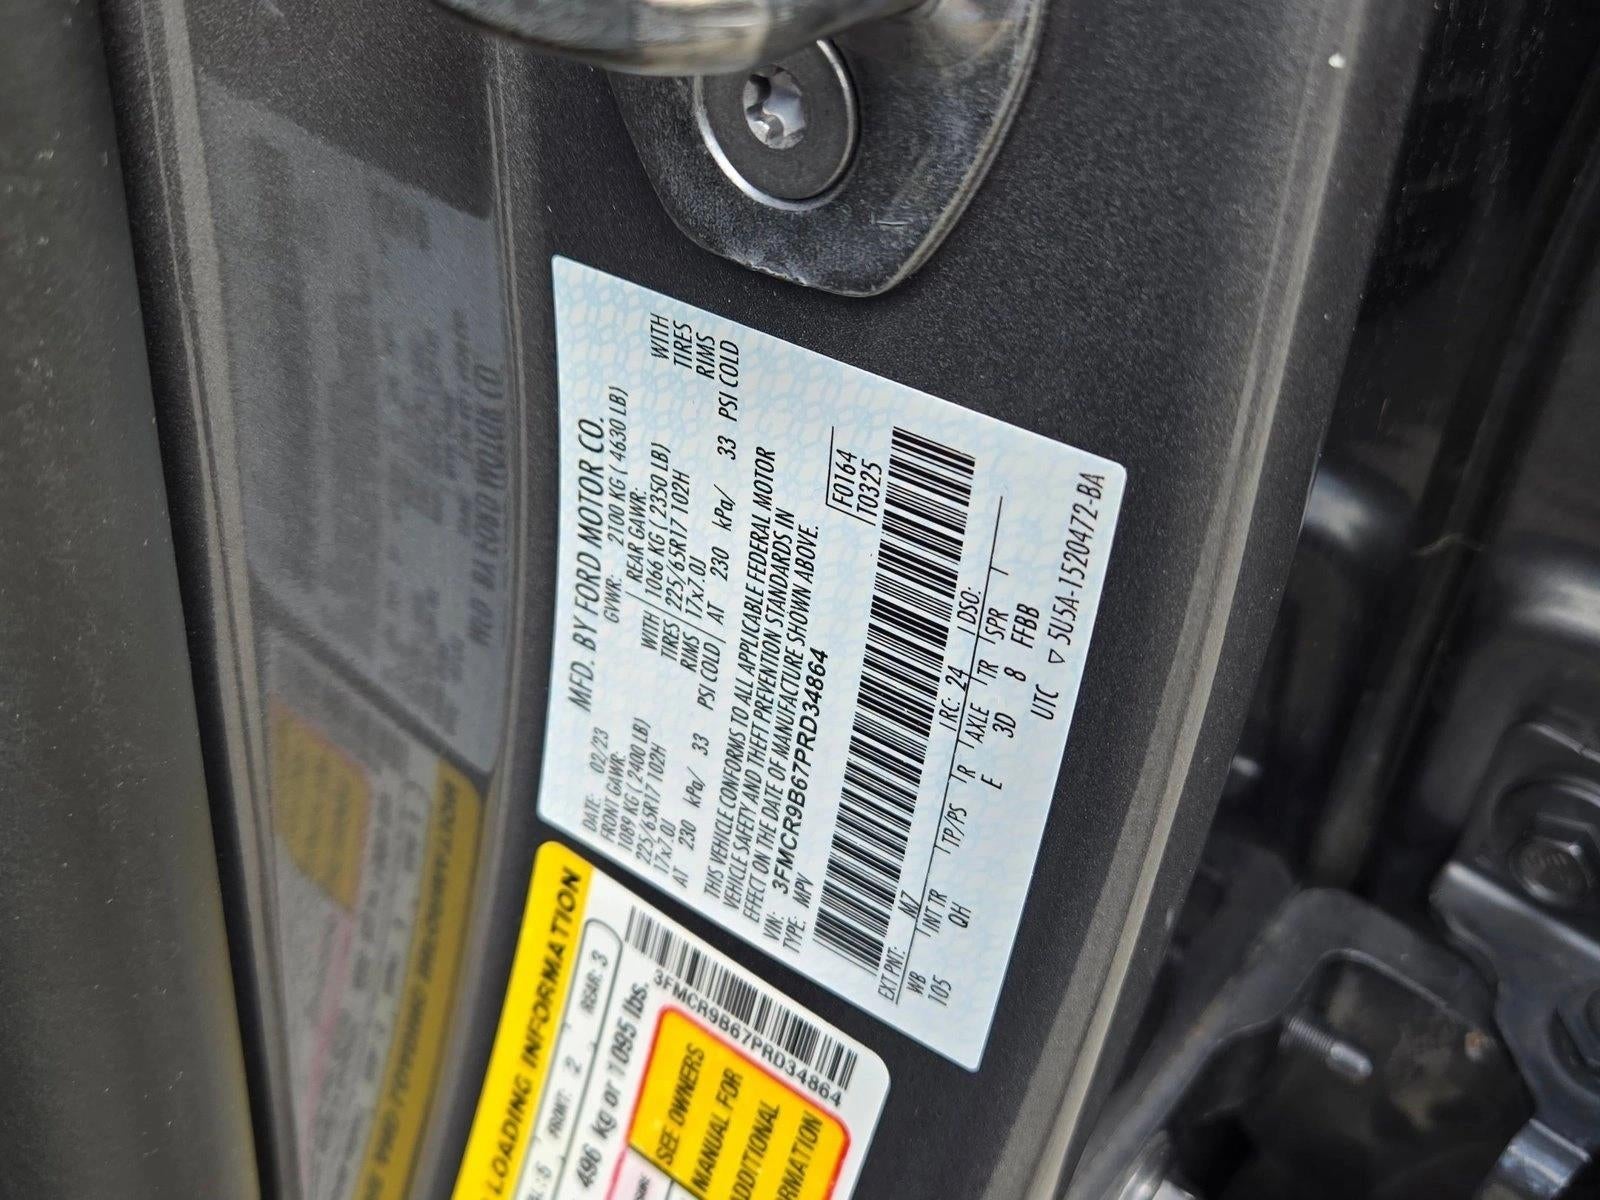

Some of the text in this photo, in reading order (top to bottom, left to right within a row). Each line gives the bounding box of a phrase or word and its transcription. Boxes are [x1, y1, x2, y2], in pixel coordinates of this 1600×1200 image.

[650, 312, 669, 360] WITH
[674, 320, 692, 369] TIRES
[696, 332, 715, 380] RIMS
[609, 386, 628, 416] LB)
[718, 340, 739, 422] PSI COLD
[609, 418, 626, 462] 4630
[651, 442, 671, 472] LB)
[608, 476, 626, 504] KG
[650, 474, 668, 519] 2350
[856, 458, 882, 516] T0325
[608, 505, 626, 546] 2100
[626, 488, 647, 584] REAR GAWR:
[648, 532, 665, 558] KG
[666, 469, 690, 611] 225/65R17 102H
[706, 436, 736, 626] AT 230 kPa/ 33
[568, 417, 605, 713] MFD. BY FORD MOTOR CO.
[645, 559, 664, 599] 1066
[685, 555, 707, 619] 17x7.0J
[604, 574, 622, 624] GVWR:
[957, 586, 982, 625] DSO:
[1030, 473, 1105, 720] UTC 5U5A-1520472-BA
[641, 610, 660, 650] WITH
[661, 620, 680, 661] TIRES
[985, 608, 1009, 640] SPR
[1010, 603, 1040, 649] FFBB
[680, 632, 700, 672] RIMS
[704, 446, 775, 900] THIS VEHICLE CONFORMS TO ALL APPLICABLE FEDERAL MOTOR
[977, 658, 998, 679] TR
[1004, 666, 1026, 682] 8
[698, 642, 720, 711] PSI COLD
[939, 665, 968, 725] RC: 24
[632, 717, 651, 744] LB)
[722, 508, 794, 911] VEHICLE SAFETY AND THEFT PREVENTION STANDARDS IN
[743, 524, 818, 924] EFFECT ON THE DATE OF MANUFACTURE SHOWN ABOVE.
[965, 702, 990, 744] AXLE
[992, 712, 1016, 738] 3D
[582, 726, 609, 832] DATE: 02/23
[630, 744, 646, 783] 2400
[956, 764, 976, 778] R
[981, 774, 1002, 790] E
[601, 752, 626, 843] FRONT GAWR:
[623, 792, 640, 817] KG
[636, 742, 667, 864] 225/65R17 102H
[672, 732, 710, 888] AT 230 kPa/ 33
[764, 647, 828, 940] VIN: 3FMCR9B67PRD34864
[618, 816, 636, 852] 1089
[942, 804, 967, 848] TP/PS
[783, 872, 814, 953] TYPE: MPV
[922, 888, 948, 934] INT TR
[948, 902, 972, 928] QH
[592, 950, 608, 967] 3
[886, 946, 906, 978] PNT:
[878, 972, 896, 1001] EXT
[906, 970, 926, 995] WB
[928, 974, 952, 1006] 105
[488, 866, 581, 1196] LOADING INFORMATION
[653, 969, 842, 1107] 3FMCR9B67PRD34864
[576, 982, 648, 1188] 496 kg or 1095 lbs.
[656, 1043, 705, 1166] SEE OWNERS
[692, 1067, 744, 1192] MANUAL FOR
[775, 1110, 823, 1200] RMATION
